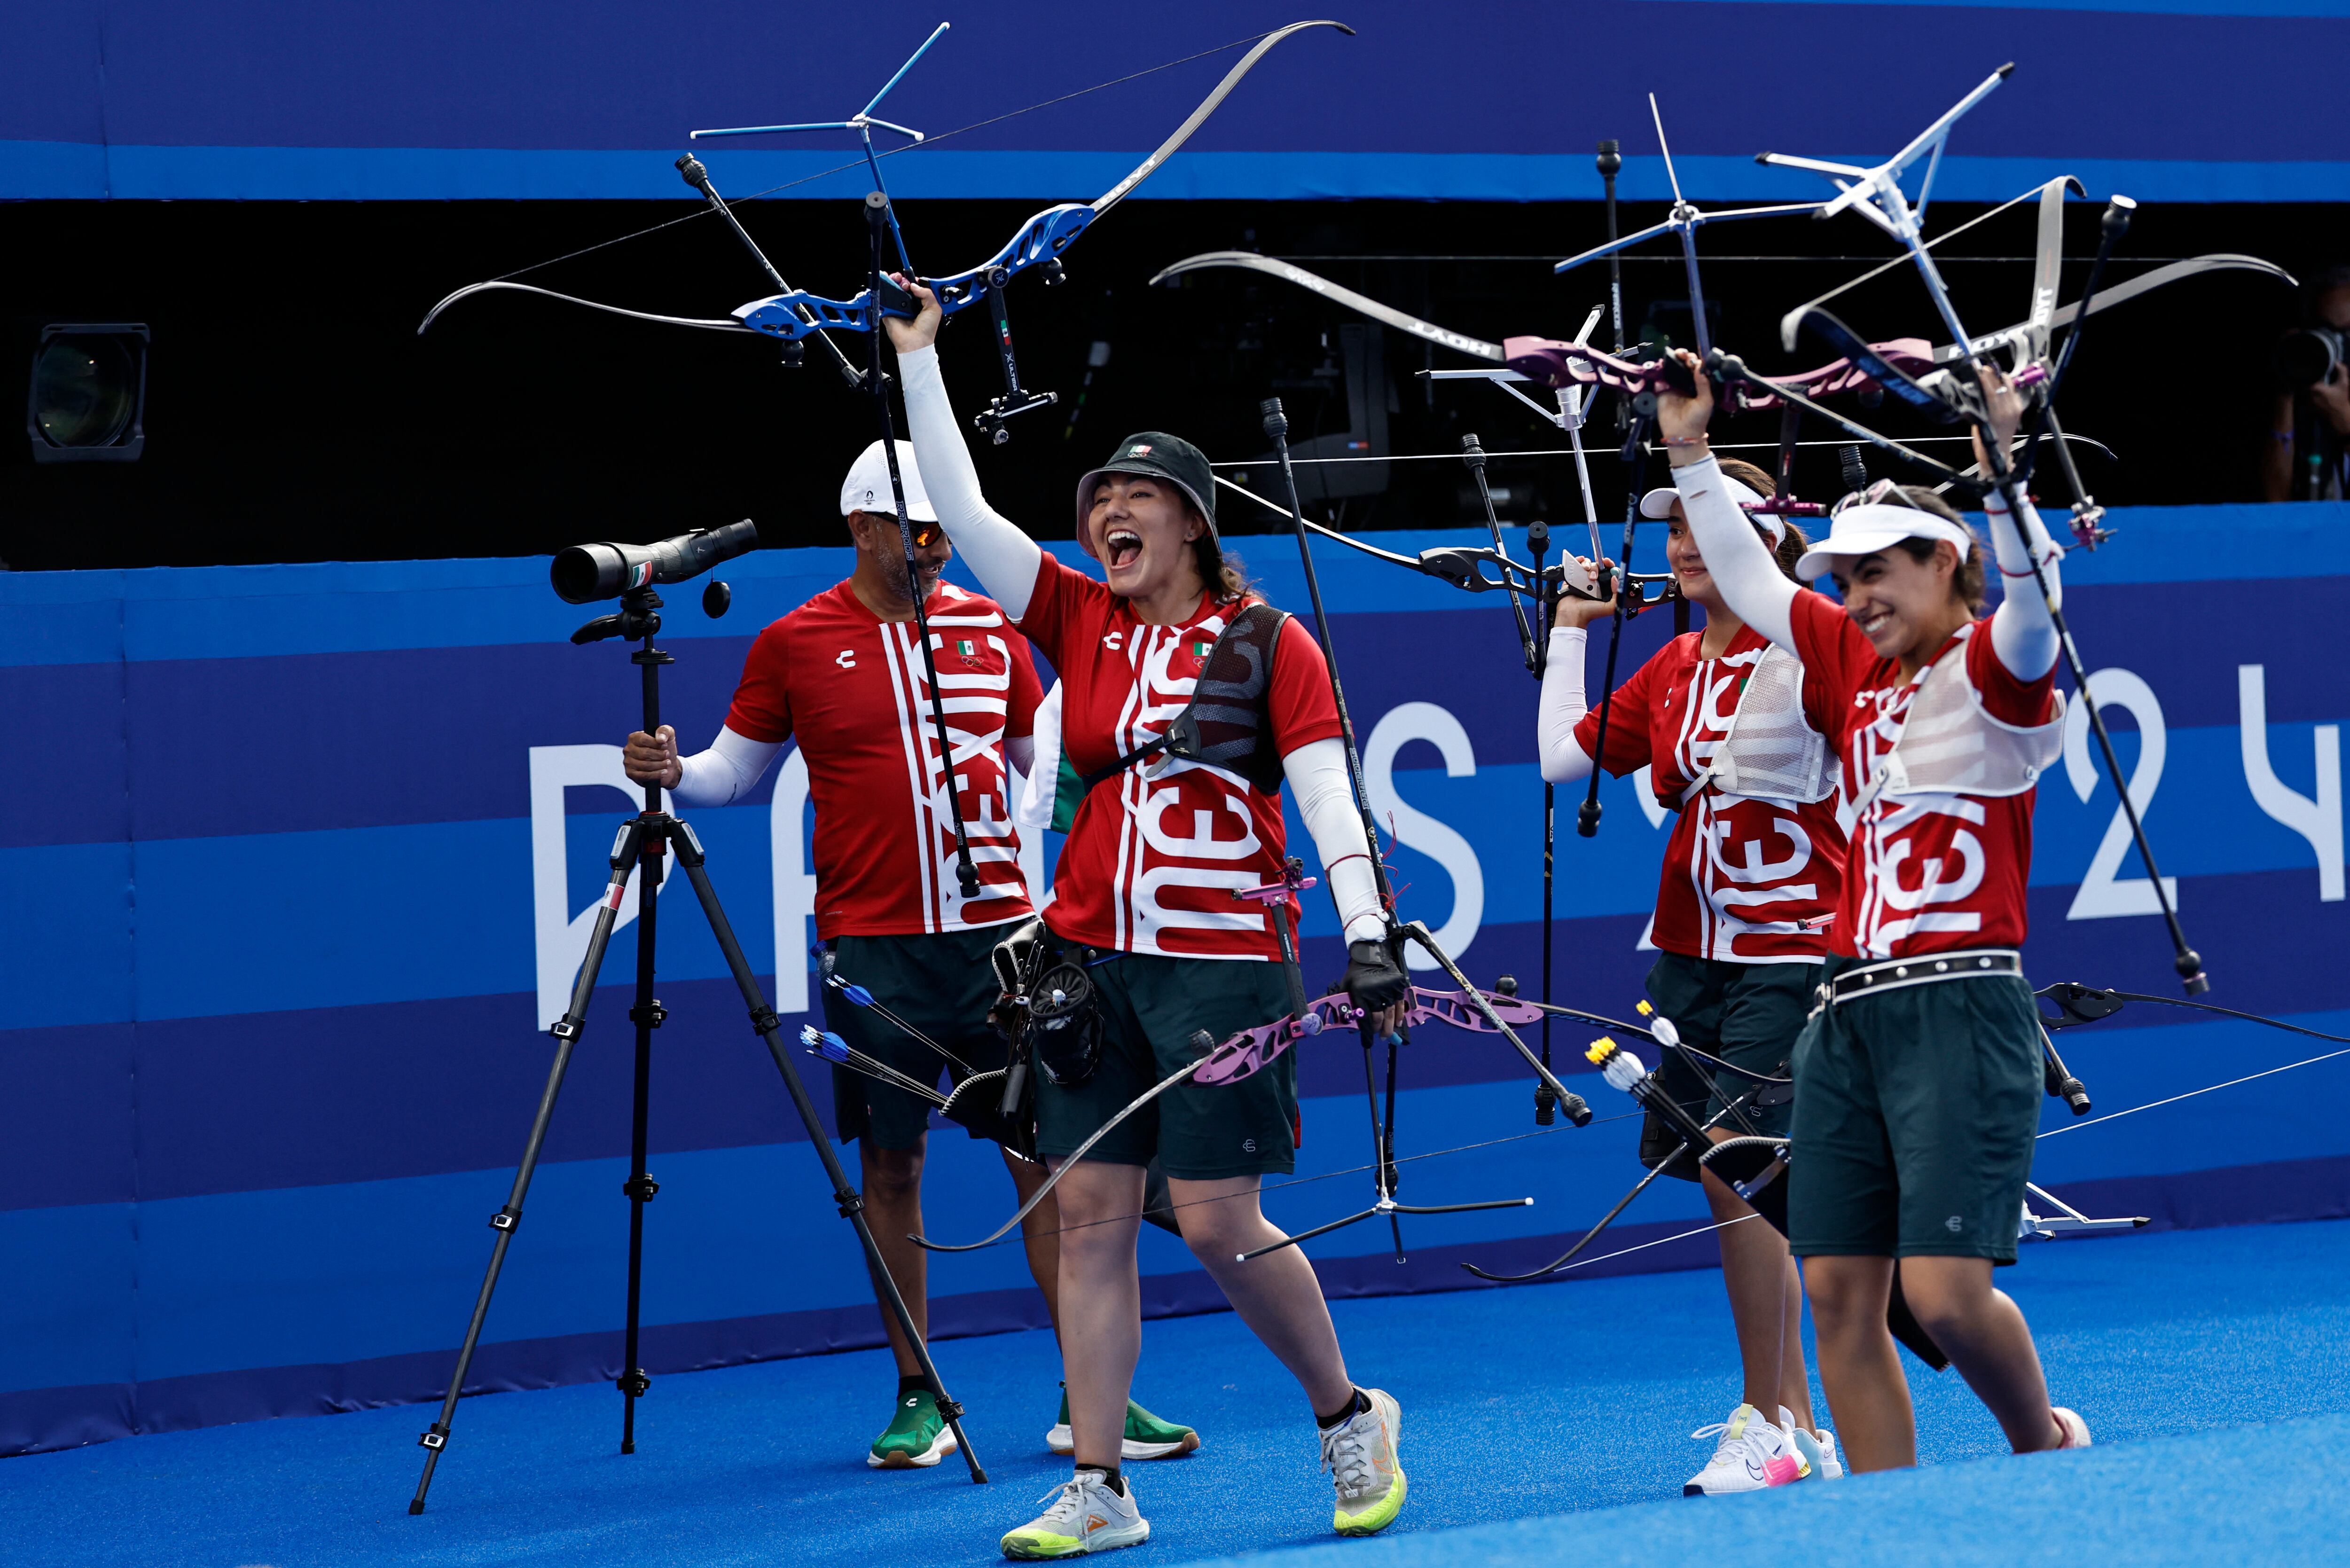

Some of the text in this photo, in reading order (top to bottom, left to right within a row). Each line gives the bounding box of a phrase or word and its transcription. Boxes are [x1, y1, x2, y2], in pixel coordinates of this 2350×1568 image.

[1100, 154, 1158, 206] HOYT
[2033, 287, 2053, 326] OYT
[1409, 322, 1491, 356] HOYT
[1009, 363, 1018, 392] ULTIMA
[895, 500, 915, 561] RAMRODS
[1349, 747, 1370, 810] RAMRODS
[1547, 1013, 1623, 1030] HOYT
